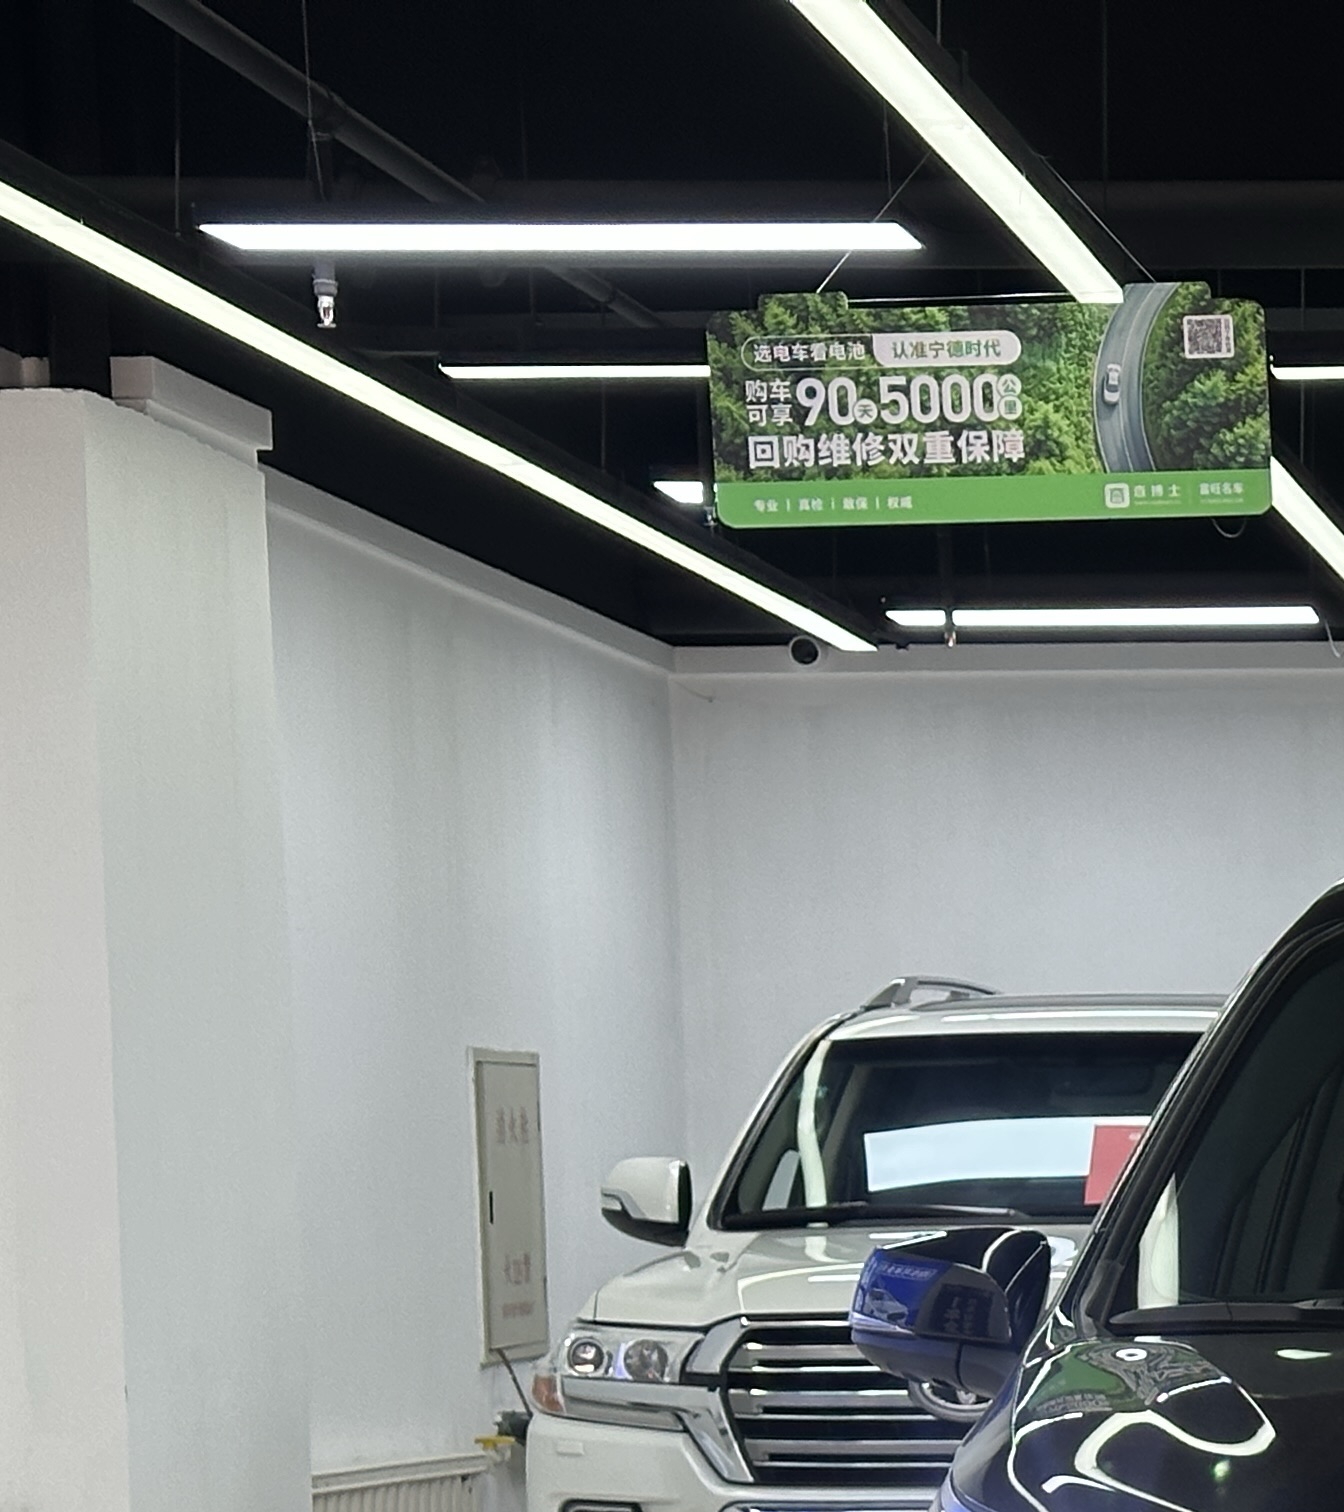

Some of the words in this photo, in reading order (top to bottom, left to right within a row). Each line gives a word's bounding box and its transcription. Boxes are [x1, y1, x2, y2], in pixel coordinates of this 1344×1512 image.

[753, 341, 866, 364] 选电车看电池
[891, 338, 1001, 360] 认准宁德时代
[745, 379, 791, 402] 购车
[746, 403, 793, 427] 可享
[748, 429, 1026, 469] 回购维修双重保障
